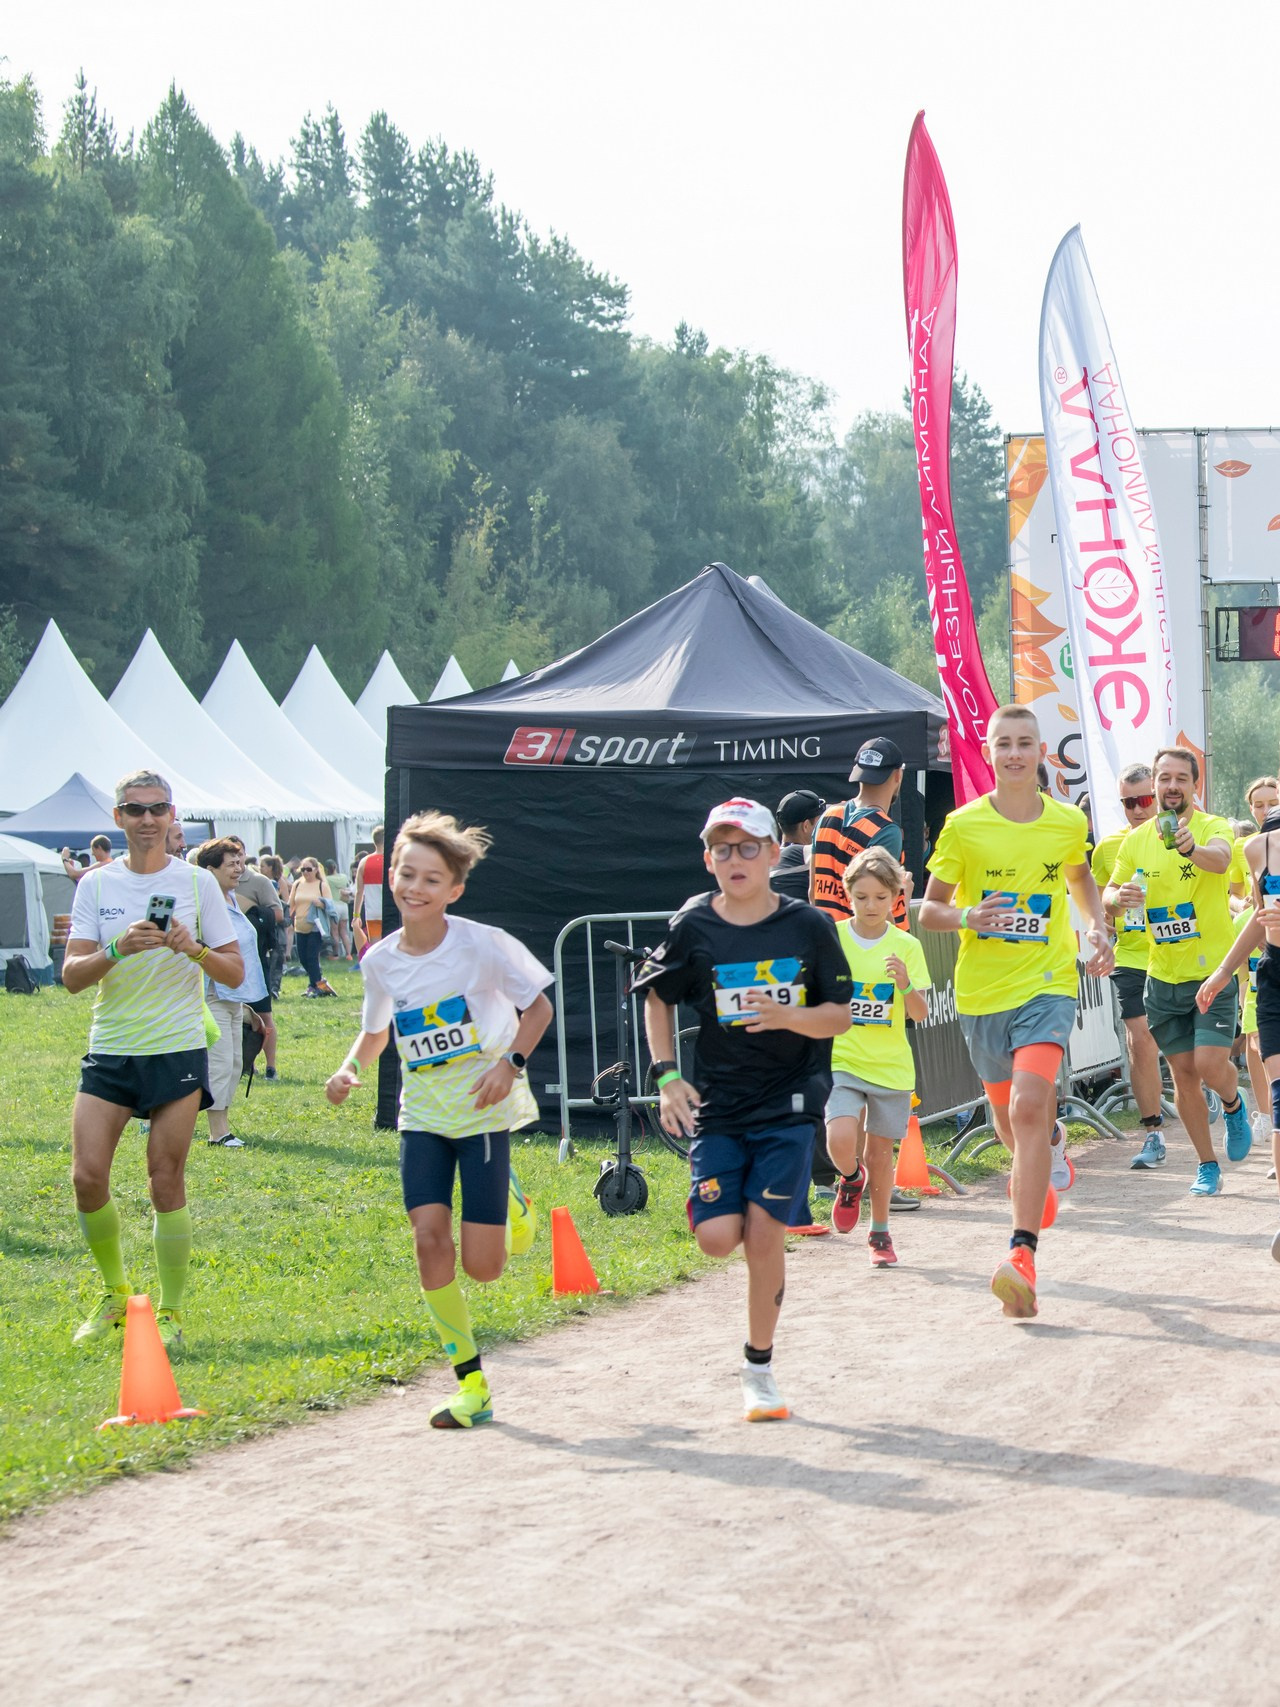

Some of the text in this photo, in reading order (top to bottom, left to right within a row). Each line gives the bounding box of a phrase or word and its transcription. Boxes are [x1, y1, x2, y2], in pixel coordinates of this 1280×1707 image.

[918, 306, 943, 518] ЛИМОНАД
[1092, 363, 1153, 531] ЛИМОНАД
[936, 529, 987, 745] ПОЛЕЗНЫЙ
[516, 732, 821, 767] 3 sport TIMING
[991, 915, 1040, 933] 228
[1156, 921, 1191, 937] 1168
[410, 1028, 464, 1057] 1160
